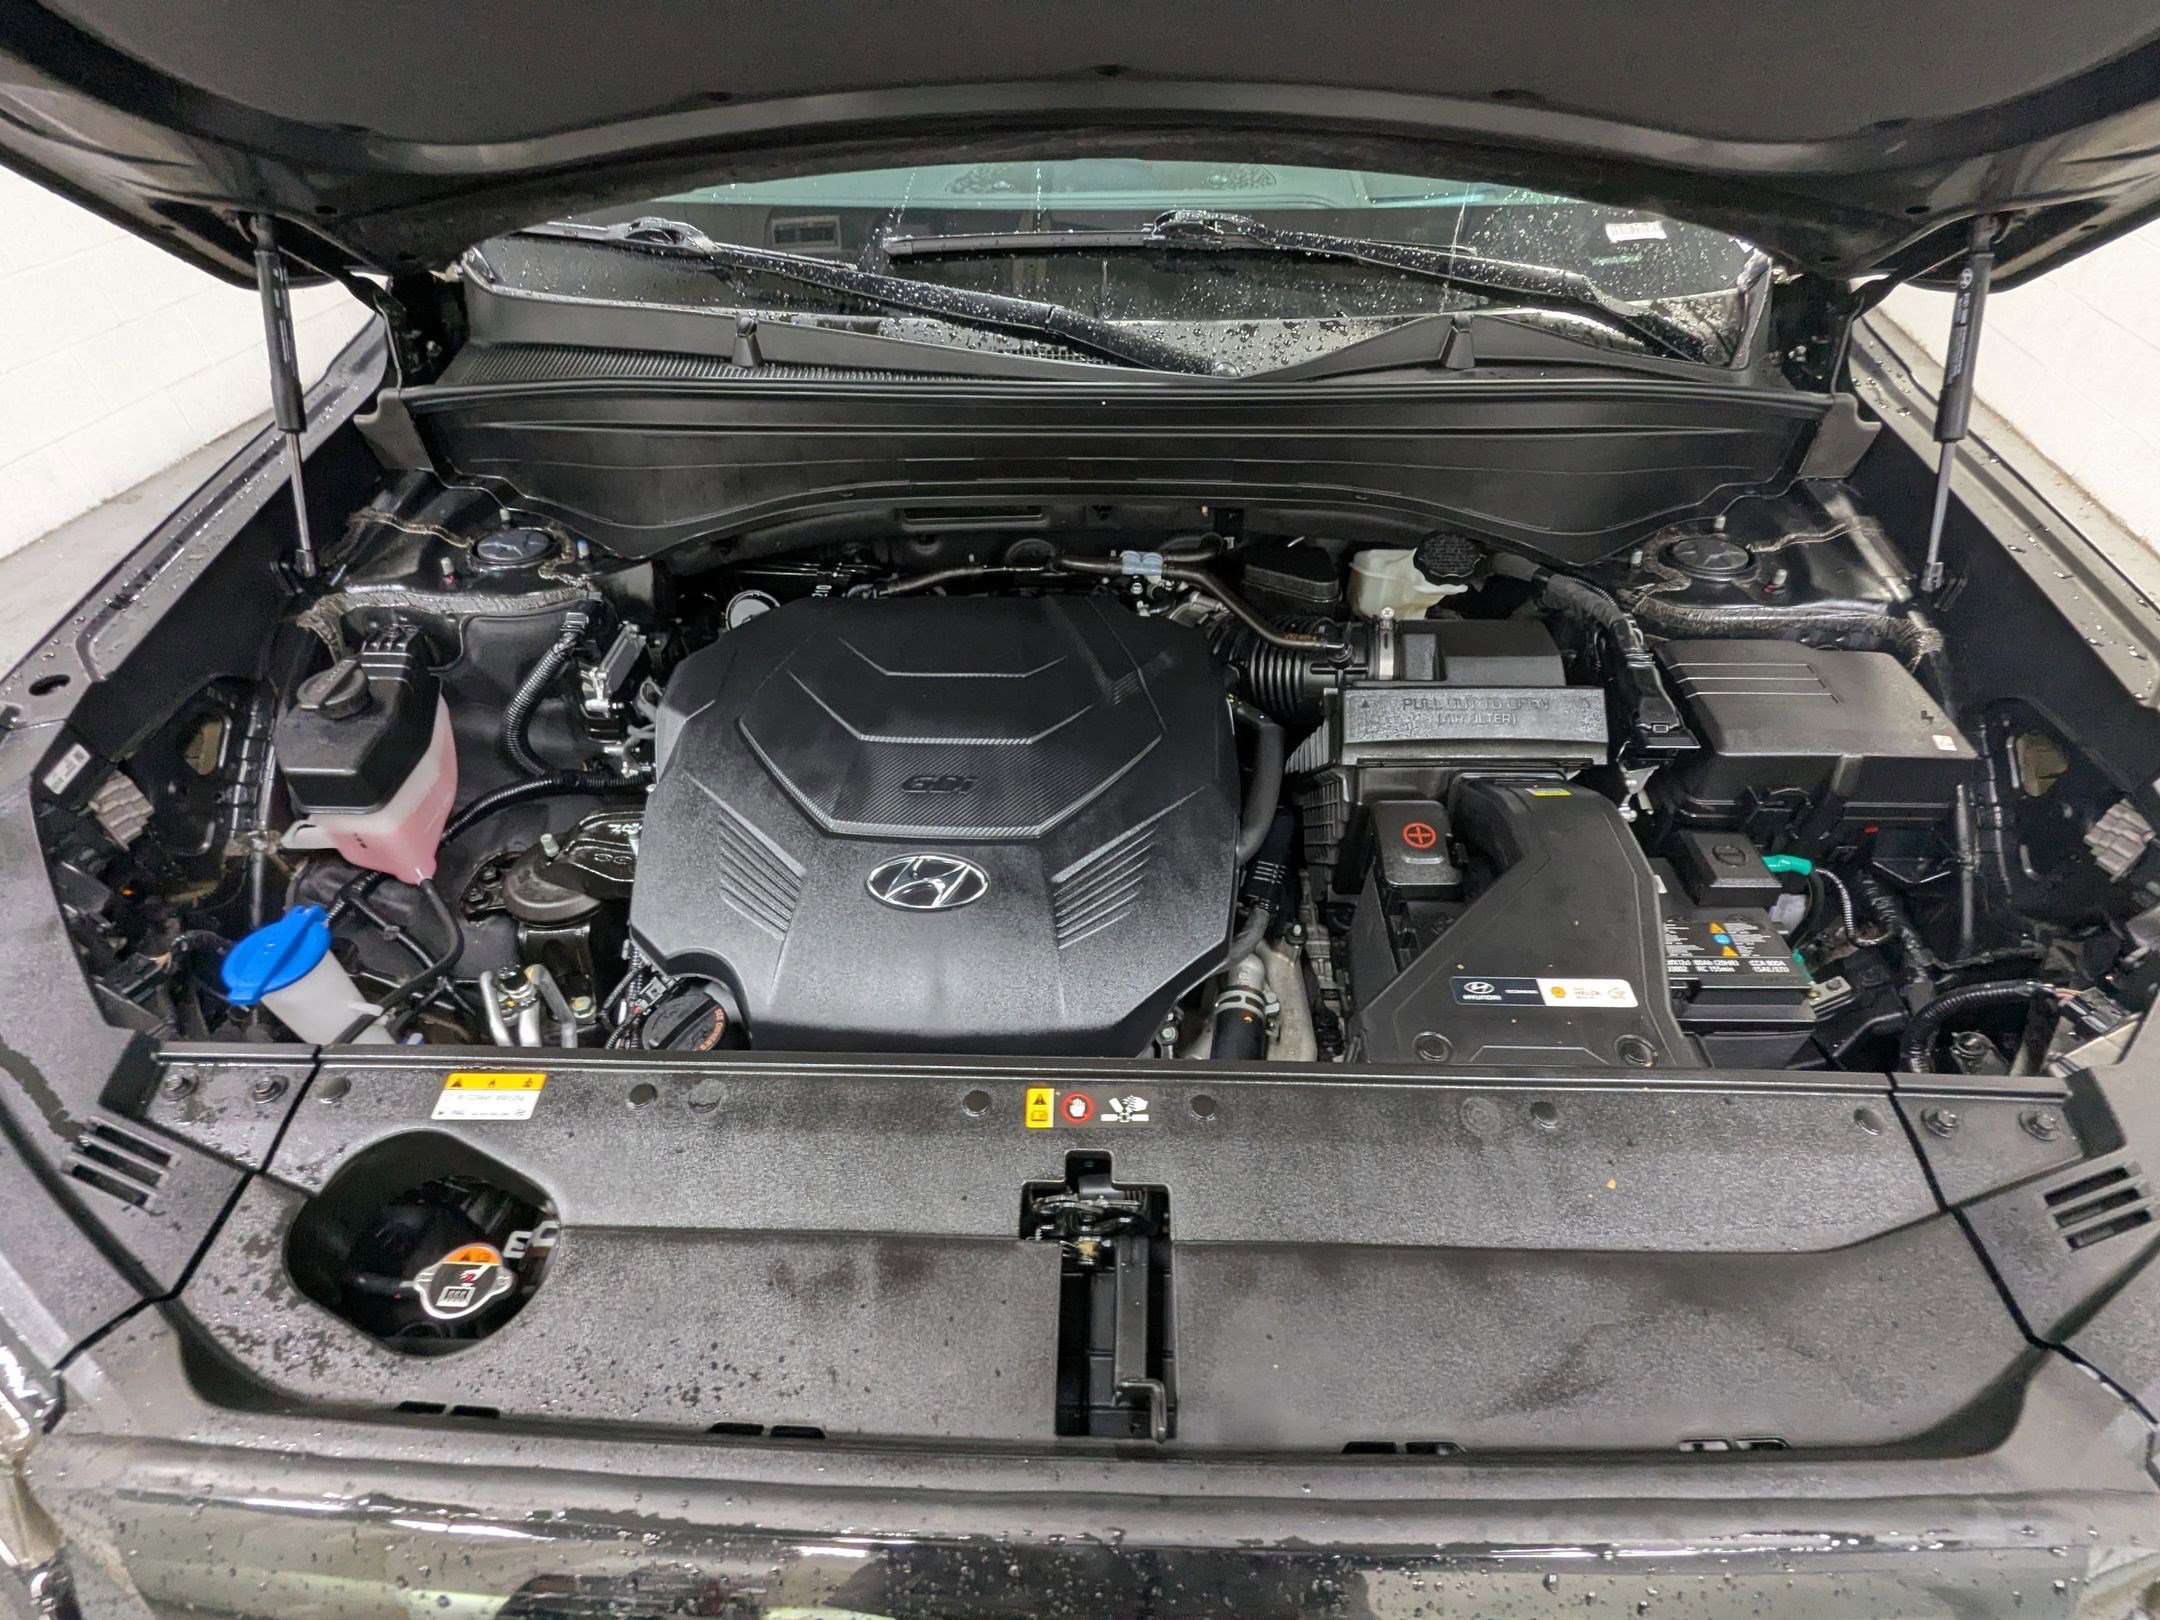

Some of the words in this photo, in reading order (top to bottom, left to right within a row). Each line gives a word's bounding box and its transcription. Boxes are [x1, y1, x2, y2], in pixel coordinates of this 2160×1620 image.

[1403, 698, 1443, 710] PULL
[1447, 698, 1478, 710] OUT
[1479, 698, 1503, 710] TO
[1507, 698, 1550, 710] OPEN
[1468, 713, 1516, 725] FILTER)
